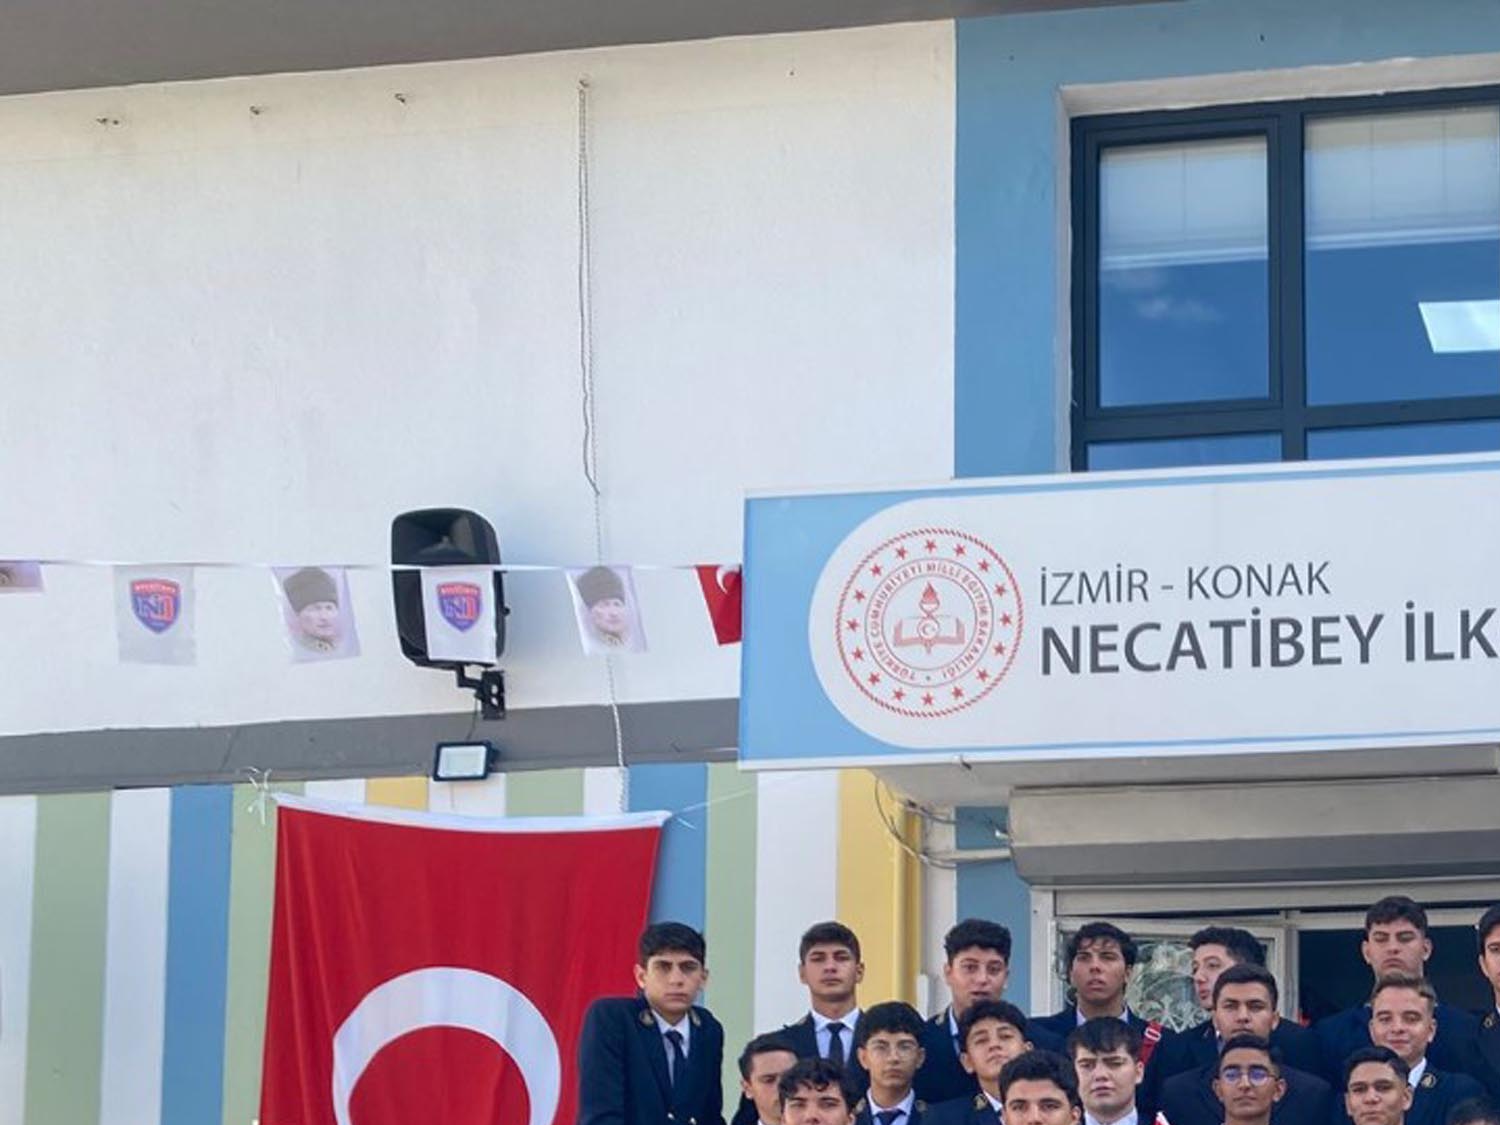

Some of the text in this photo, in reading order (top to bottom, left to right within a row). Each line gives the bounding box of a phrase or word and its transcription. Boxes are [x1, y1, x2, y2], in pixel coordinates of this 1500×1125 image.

[1041, 563, 1148, 606] İZMİR
[1187, 560, 1330, 601] KONAK
[1042, 606, 1384, 676] NECATİBEY
